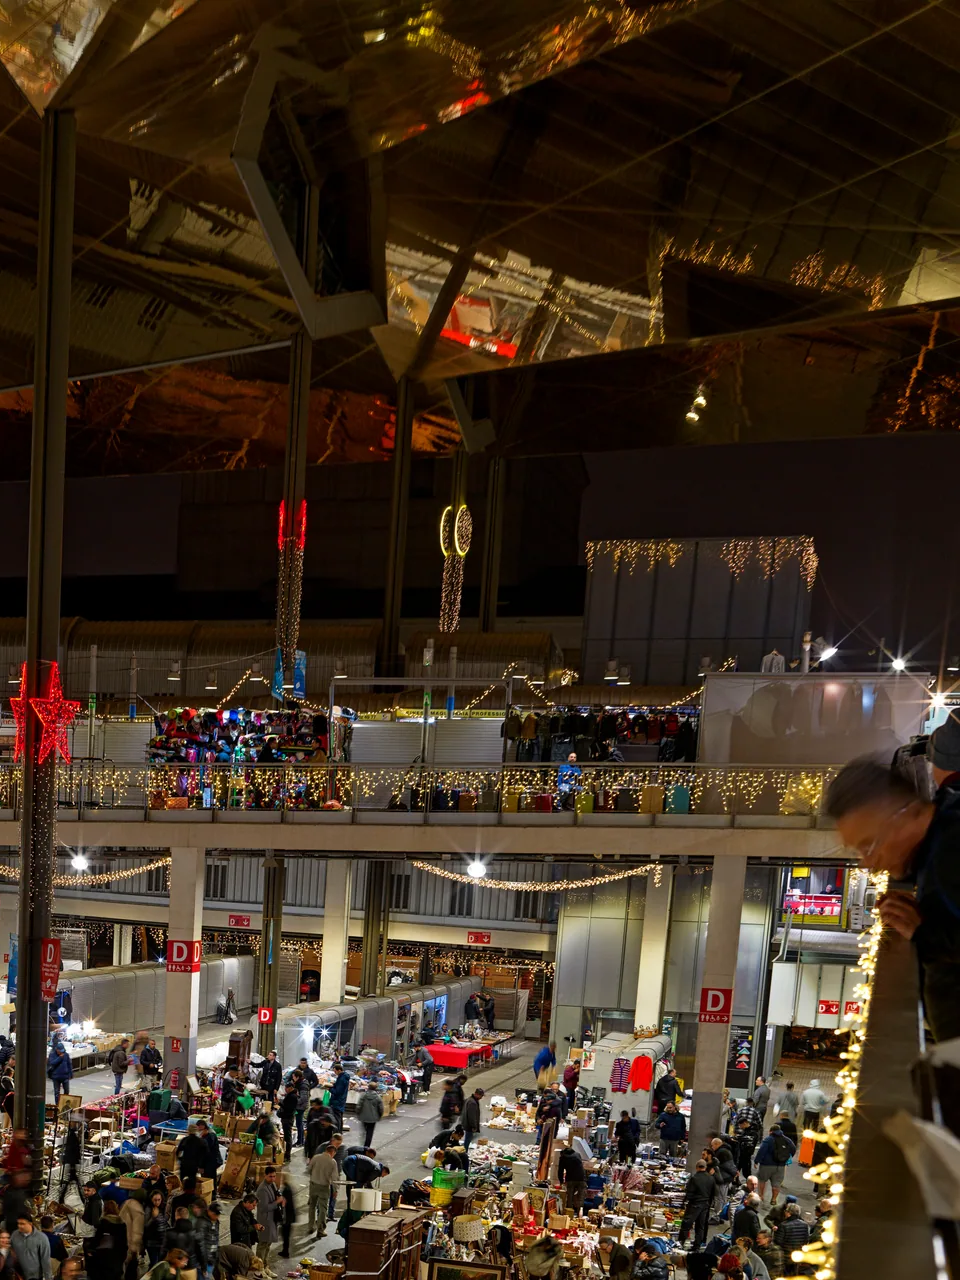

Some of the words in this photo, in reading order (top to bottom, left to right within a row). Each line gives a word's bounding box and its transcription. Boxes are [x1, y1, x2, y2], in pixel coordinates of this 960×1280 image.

[47, 943, 55, 963] D
[172, 942, 188, 962] D
[194, 942, 200, 963] D
[706, 990, 725, 1012] D
[260, 1009, 270, 1021] D
